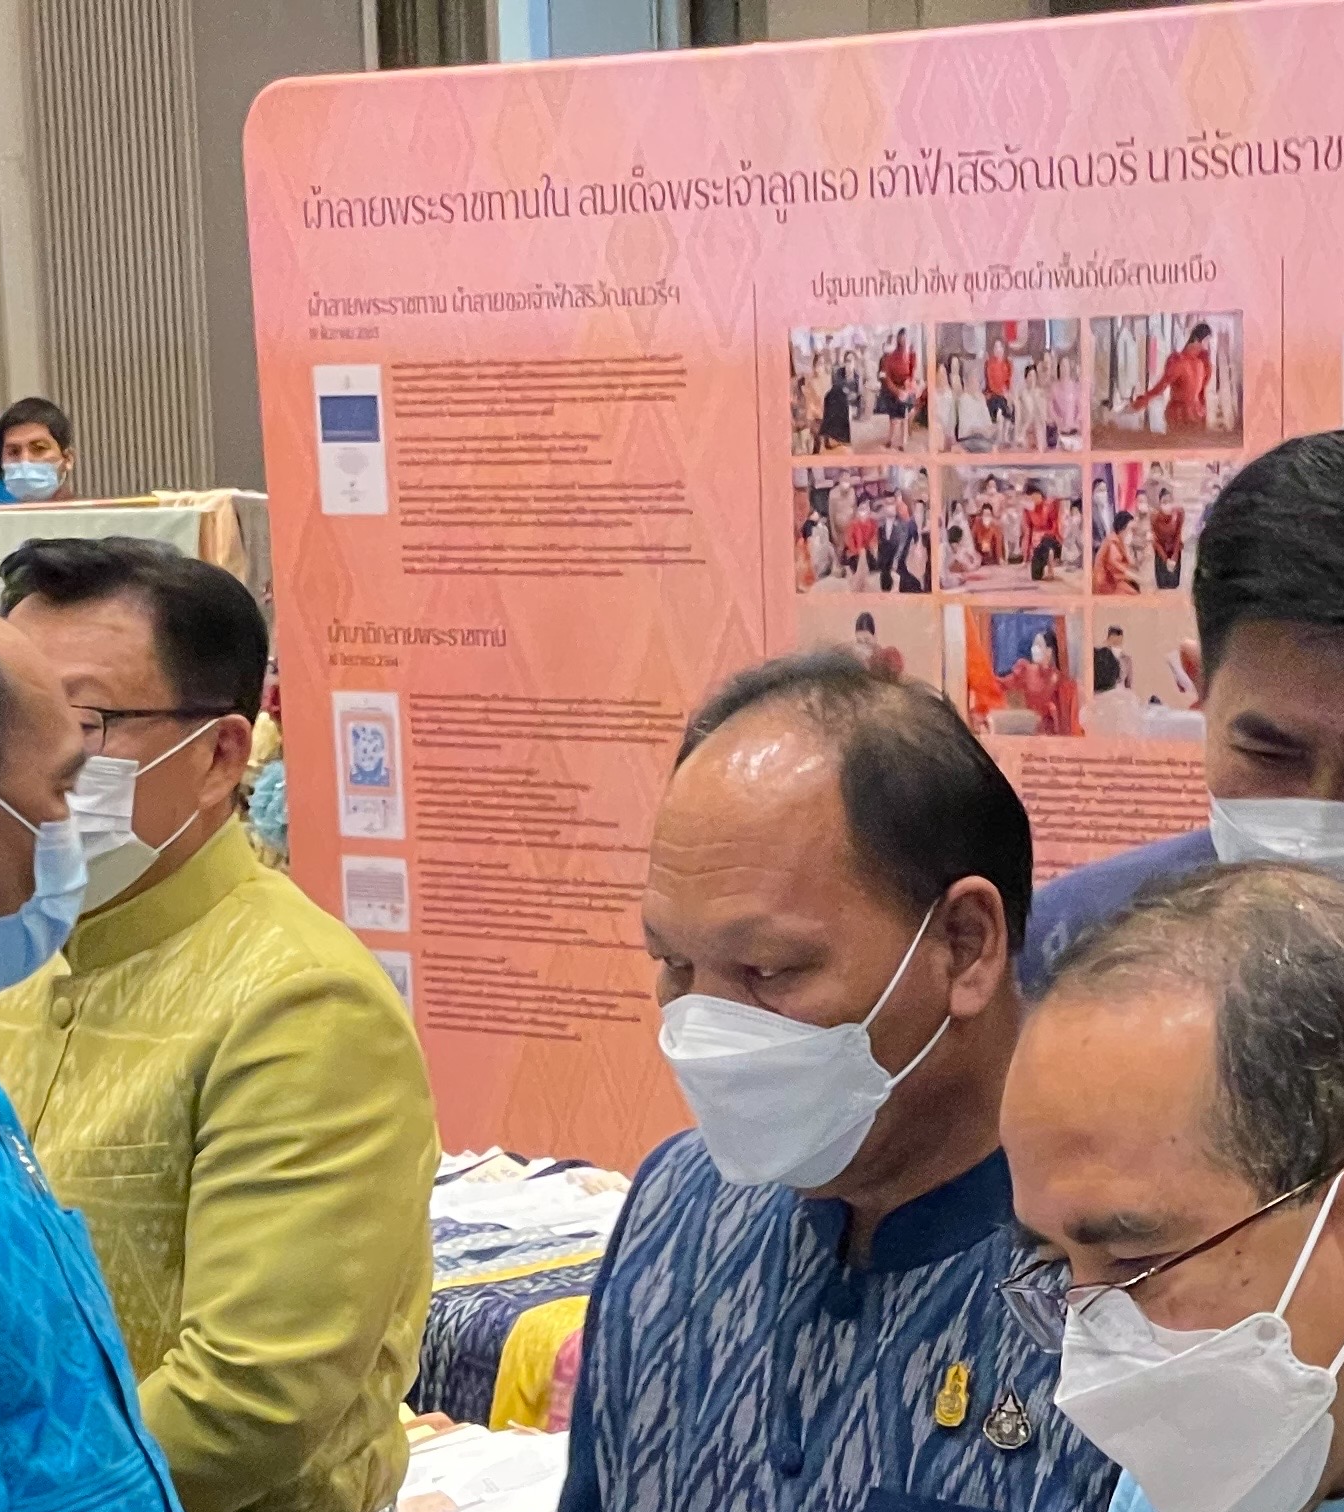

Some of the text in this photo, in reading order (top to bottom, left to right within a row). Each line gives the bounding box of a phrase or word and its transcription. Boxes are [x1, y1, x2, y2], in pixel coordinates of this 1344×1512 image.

[578, 159, 858, 224] สมเด็จพระเจ้าลูกเธอ
